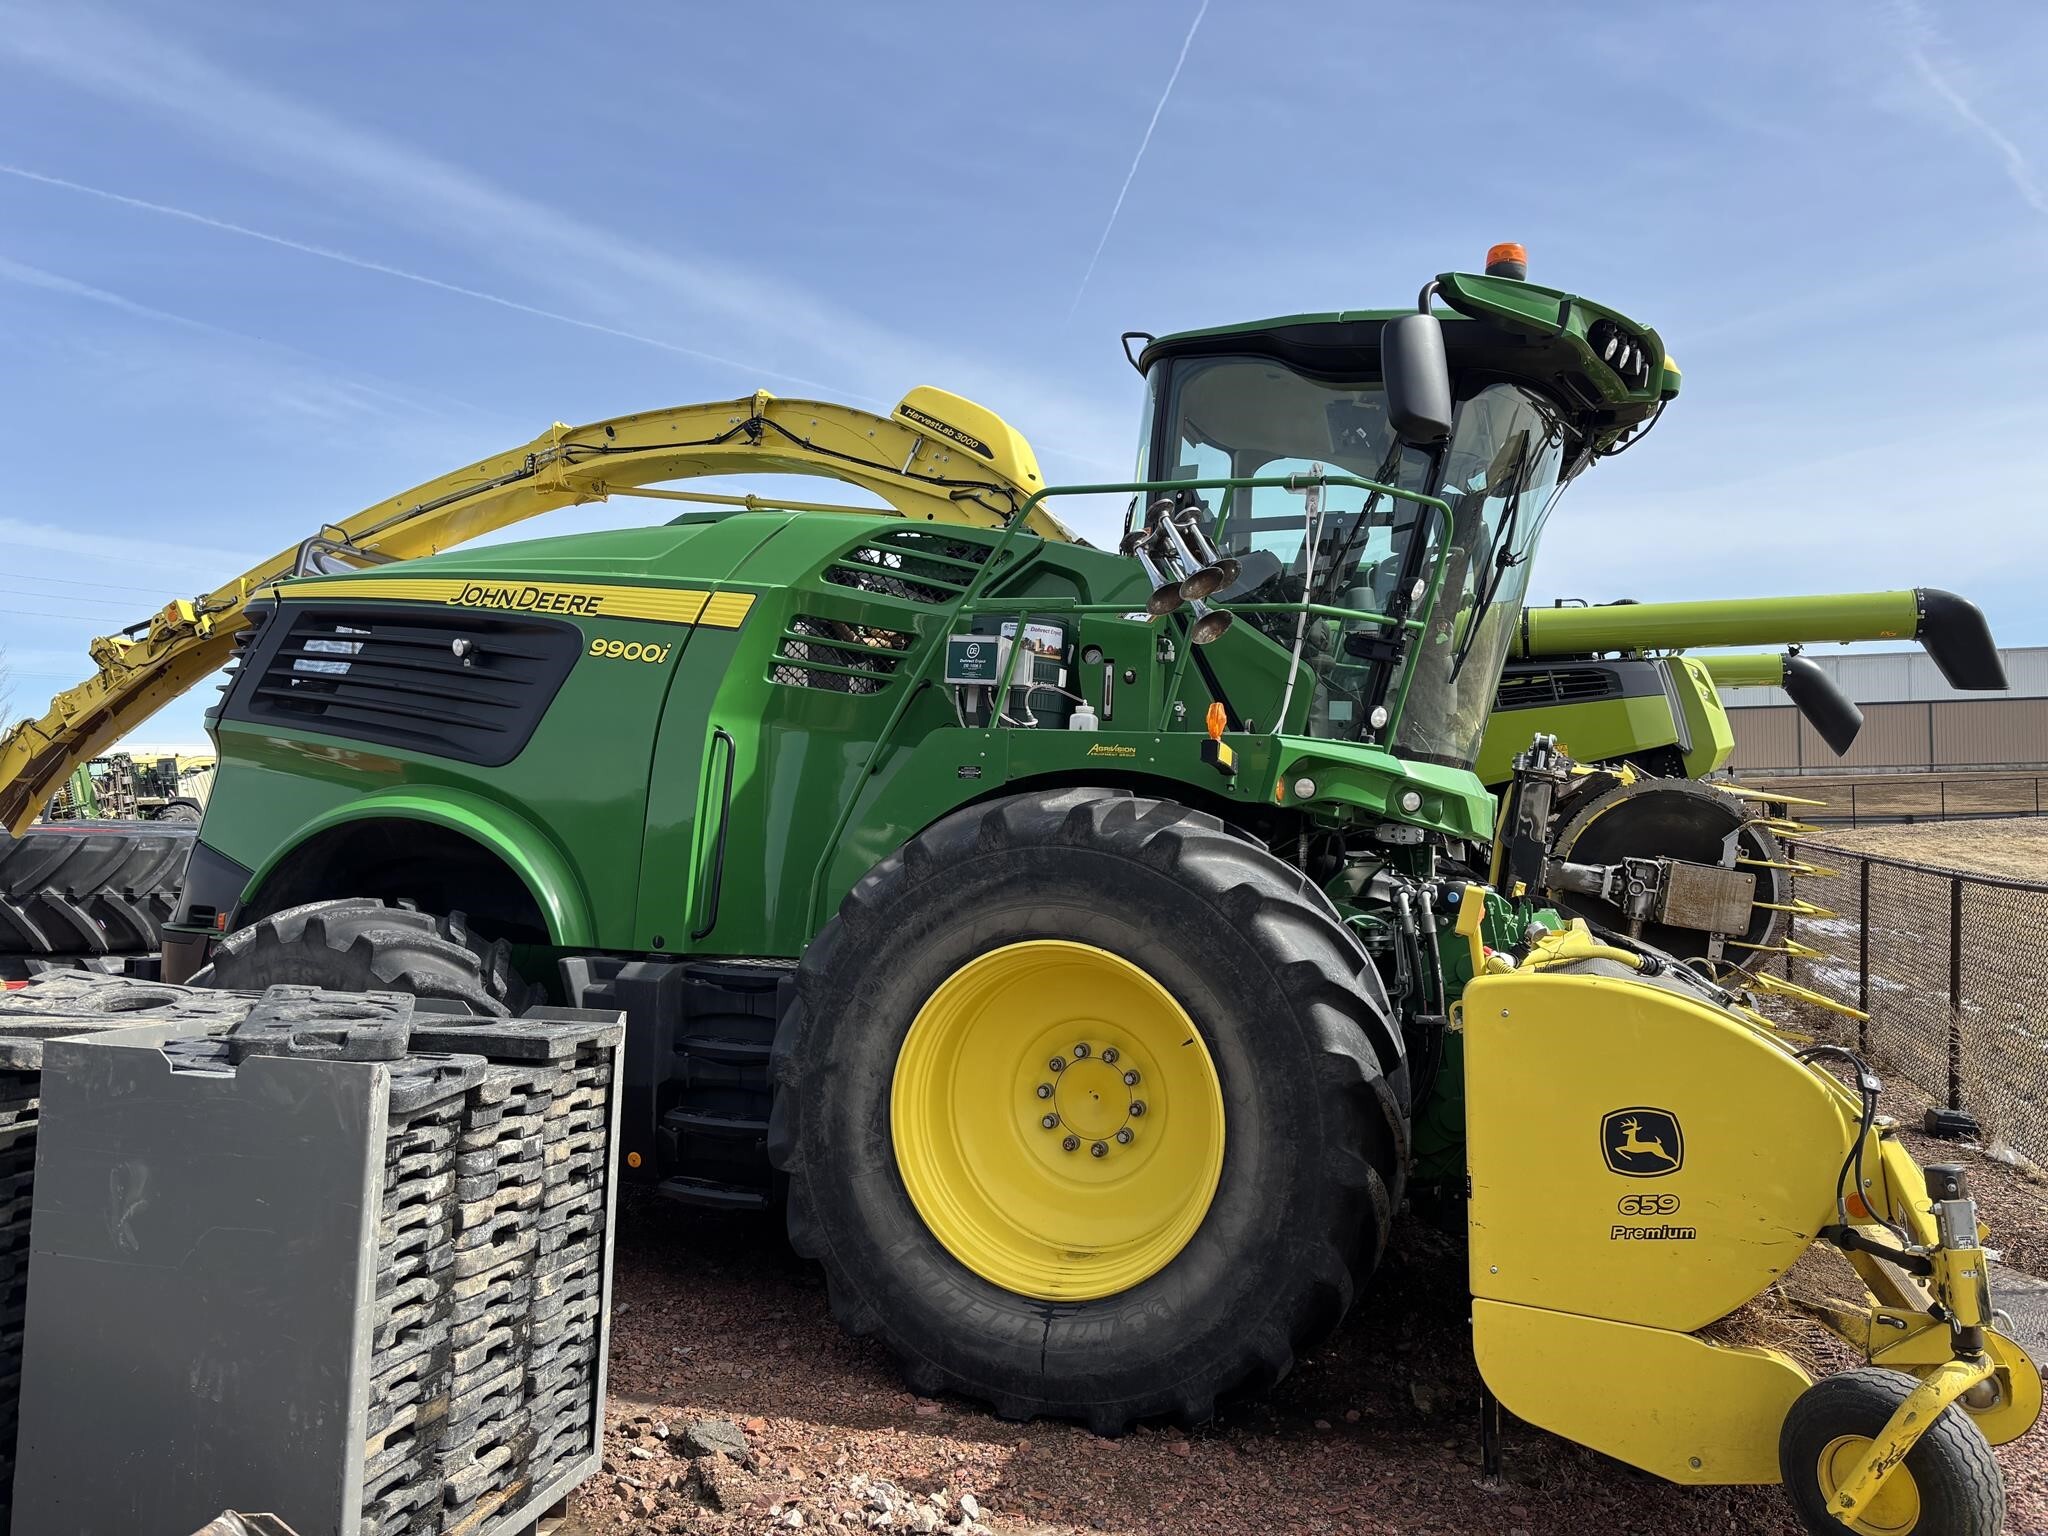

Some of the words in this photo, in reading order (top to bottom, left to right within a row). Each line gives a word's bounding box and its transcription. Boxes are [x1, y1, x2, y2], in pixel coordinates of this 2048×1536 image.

[905, 408, 954, 437] HarvestLab
[954, 432, 979, 449] 3000
[450, 582, 517, 608] JOHN
[515, 586, 604, 615] DEERE
[588, 637, 672, 664] 9900i
[1617, 1193, 1681, 1216] 659
[1610, 1224, 1697, 1240] Premium
